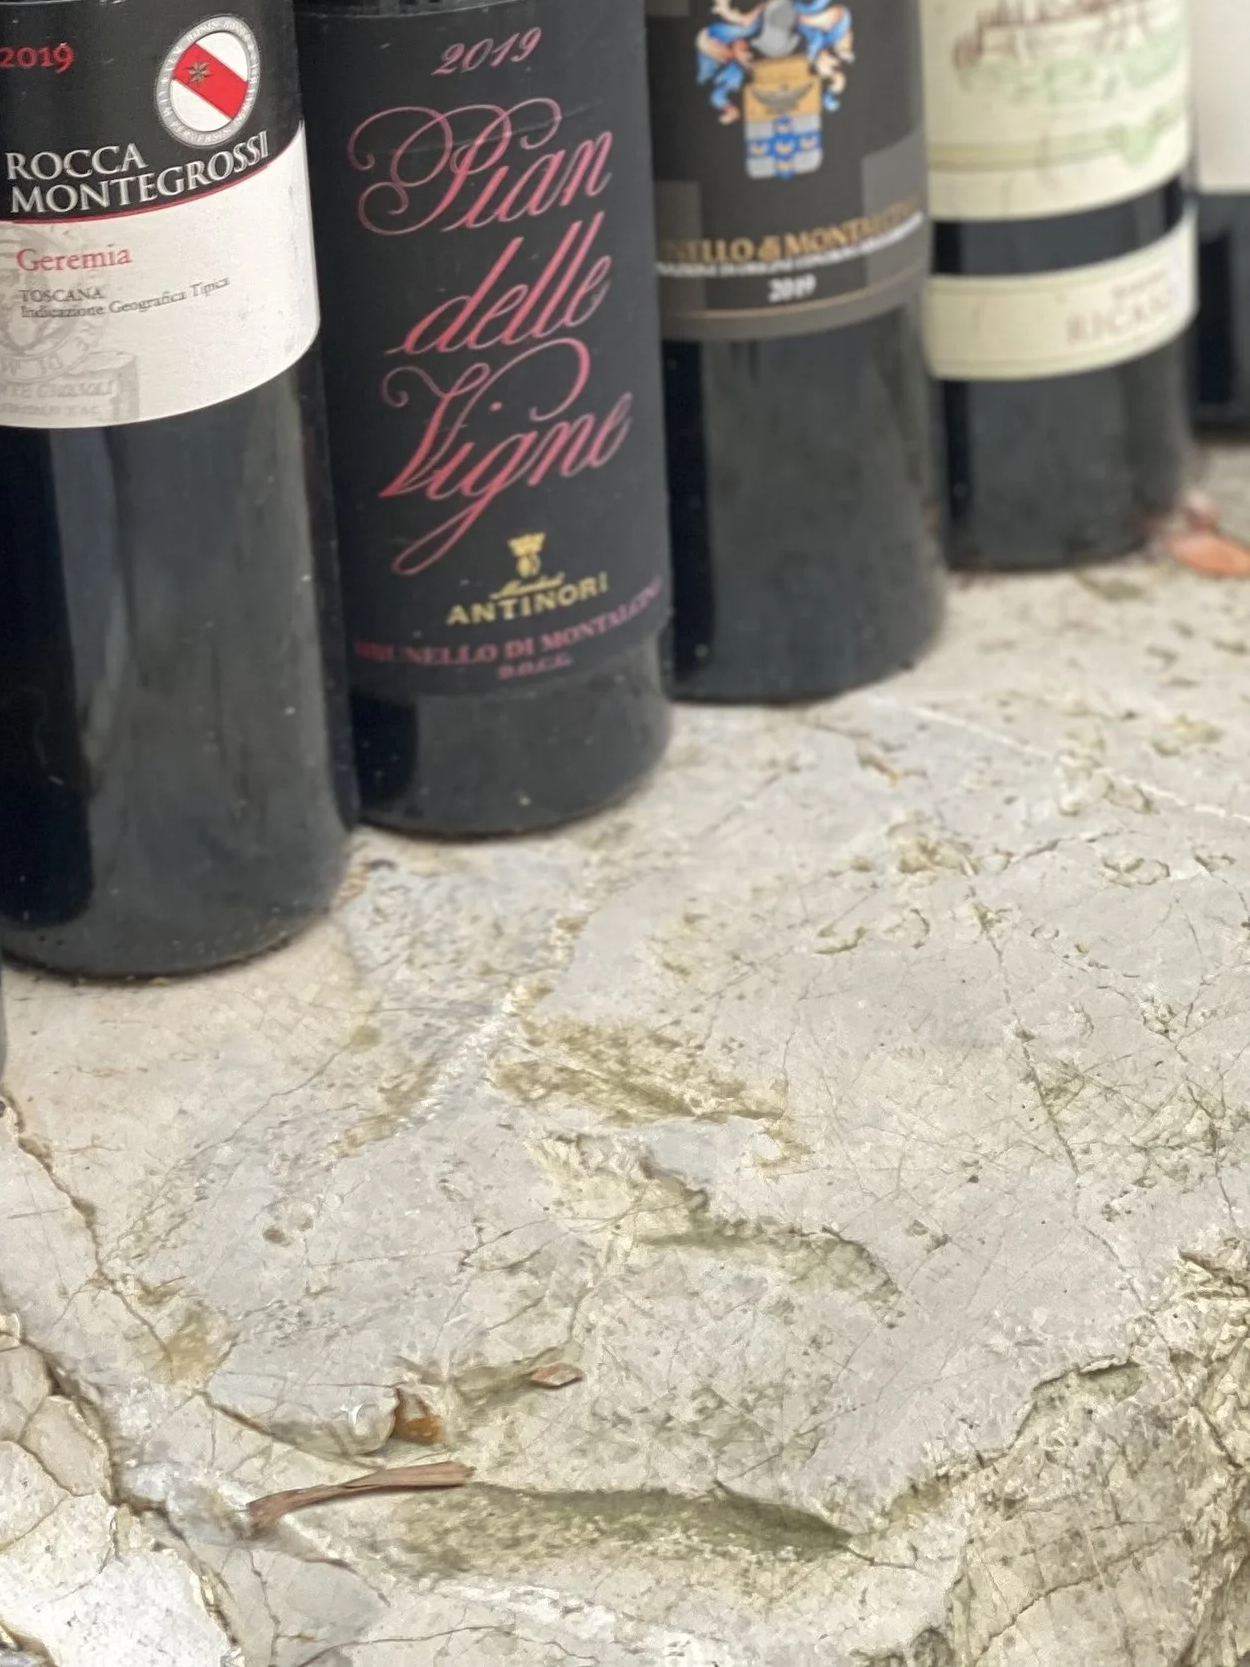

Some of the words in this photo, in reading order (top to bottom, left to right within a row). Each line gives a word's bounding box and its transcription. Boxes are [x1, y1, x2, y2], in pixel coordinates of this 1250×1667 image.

[429, 26, 542, 76] 2019
[5, 143, 149, 181] ROCCA
[10, 130, 271, 214] MONTEGROSSI
[350, 97, 613, 236] Pian
[15, 242, 134, 272] Geremia
[18, 286, 107, 304] TOSCANA
[108, 289, 188, 315] Geografica
[383, 210, 613, 355] delle
[378, 337, 634, 576] Vigne
[446, 571, 609, 626] ANTINORI
[504, 637, 534, 659] DI
